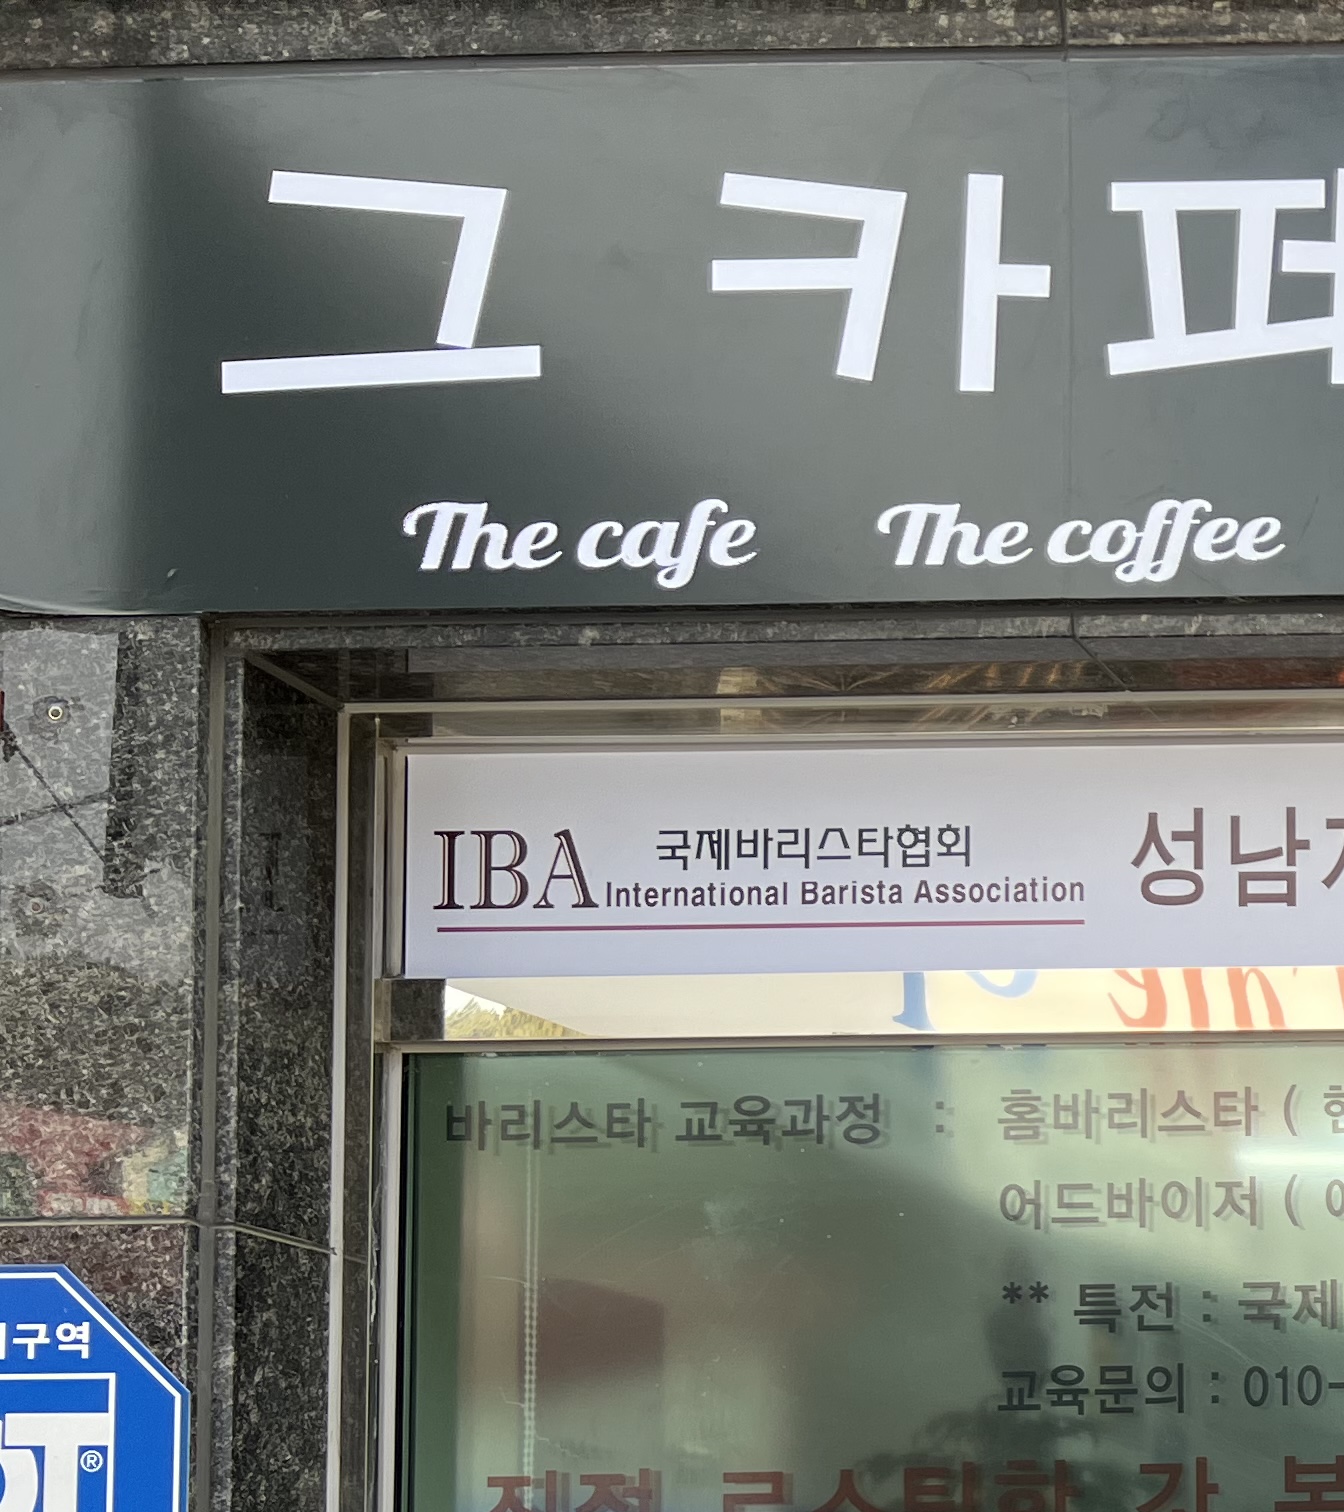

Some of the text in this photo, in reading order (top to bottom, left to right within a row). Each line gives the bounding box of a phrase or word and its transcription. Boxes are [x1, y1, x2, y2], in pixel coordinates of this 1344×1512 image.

[220, 169, 543, 395] 그
[403, 498, 1287, 589] The cafe The coffee
[432, 828, 1087, 911] IBA International Barista Association
[655, 823, 973, 871] 국제바리스타협회
[445, 1095, 655, 1150] 바리스타
[674, 1091, 886, 1147] 교육과정
[997, 1084, 1260, 1141] 홈바리스타
[1000, 1174, 1261, 1230] 어드바이저
[1073, 1281, 1178, 1333] 특전
[997, 1363, 1187, 1417] 교육문의
